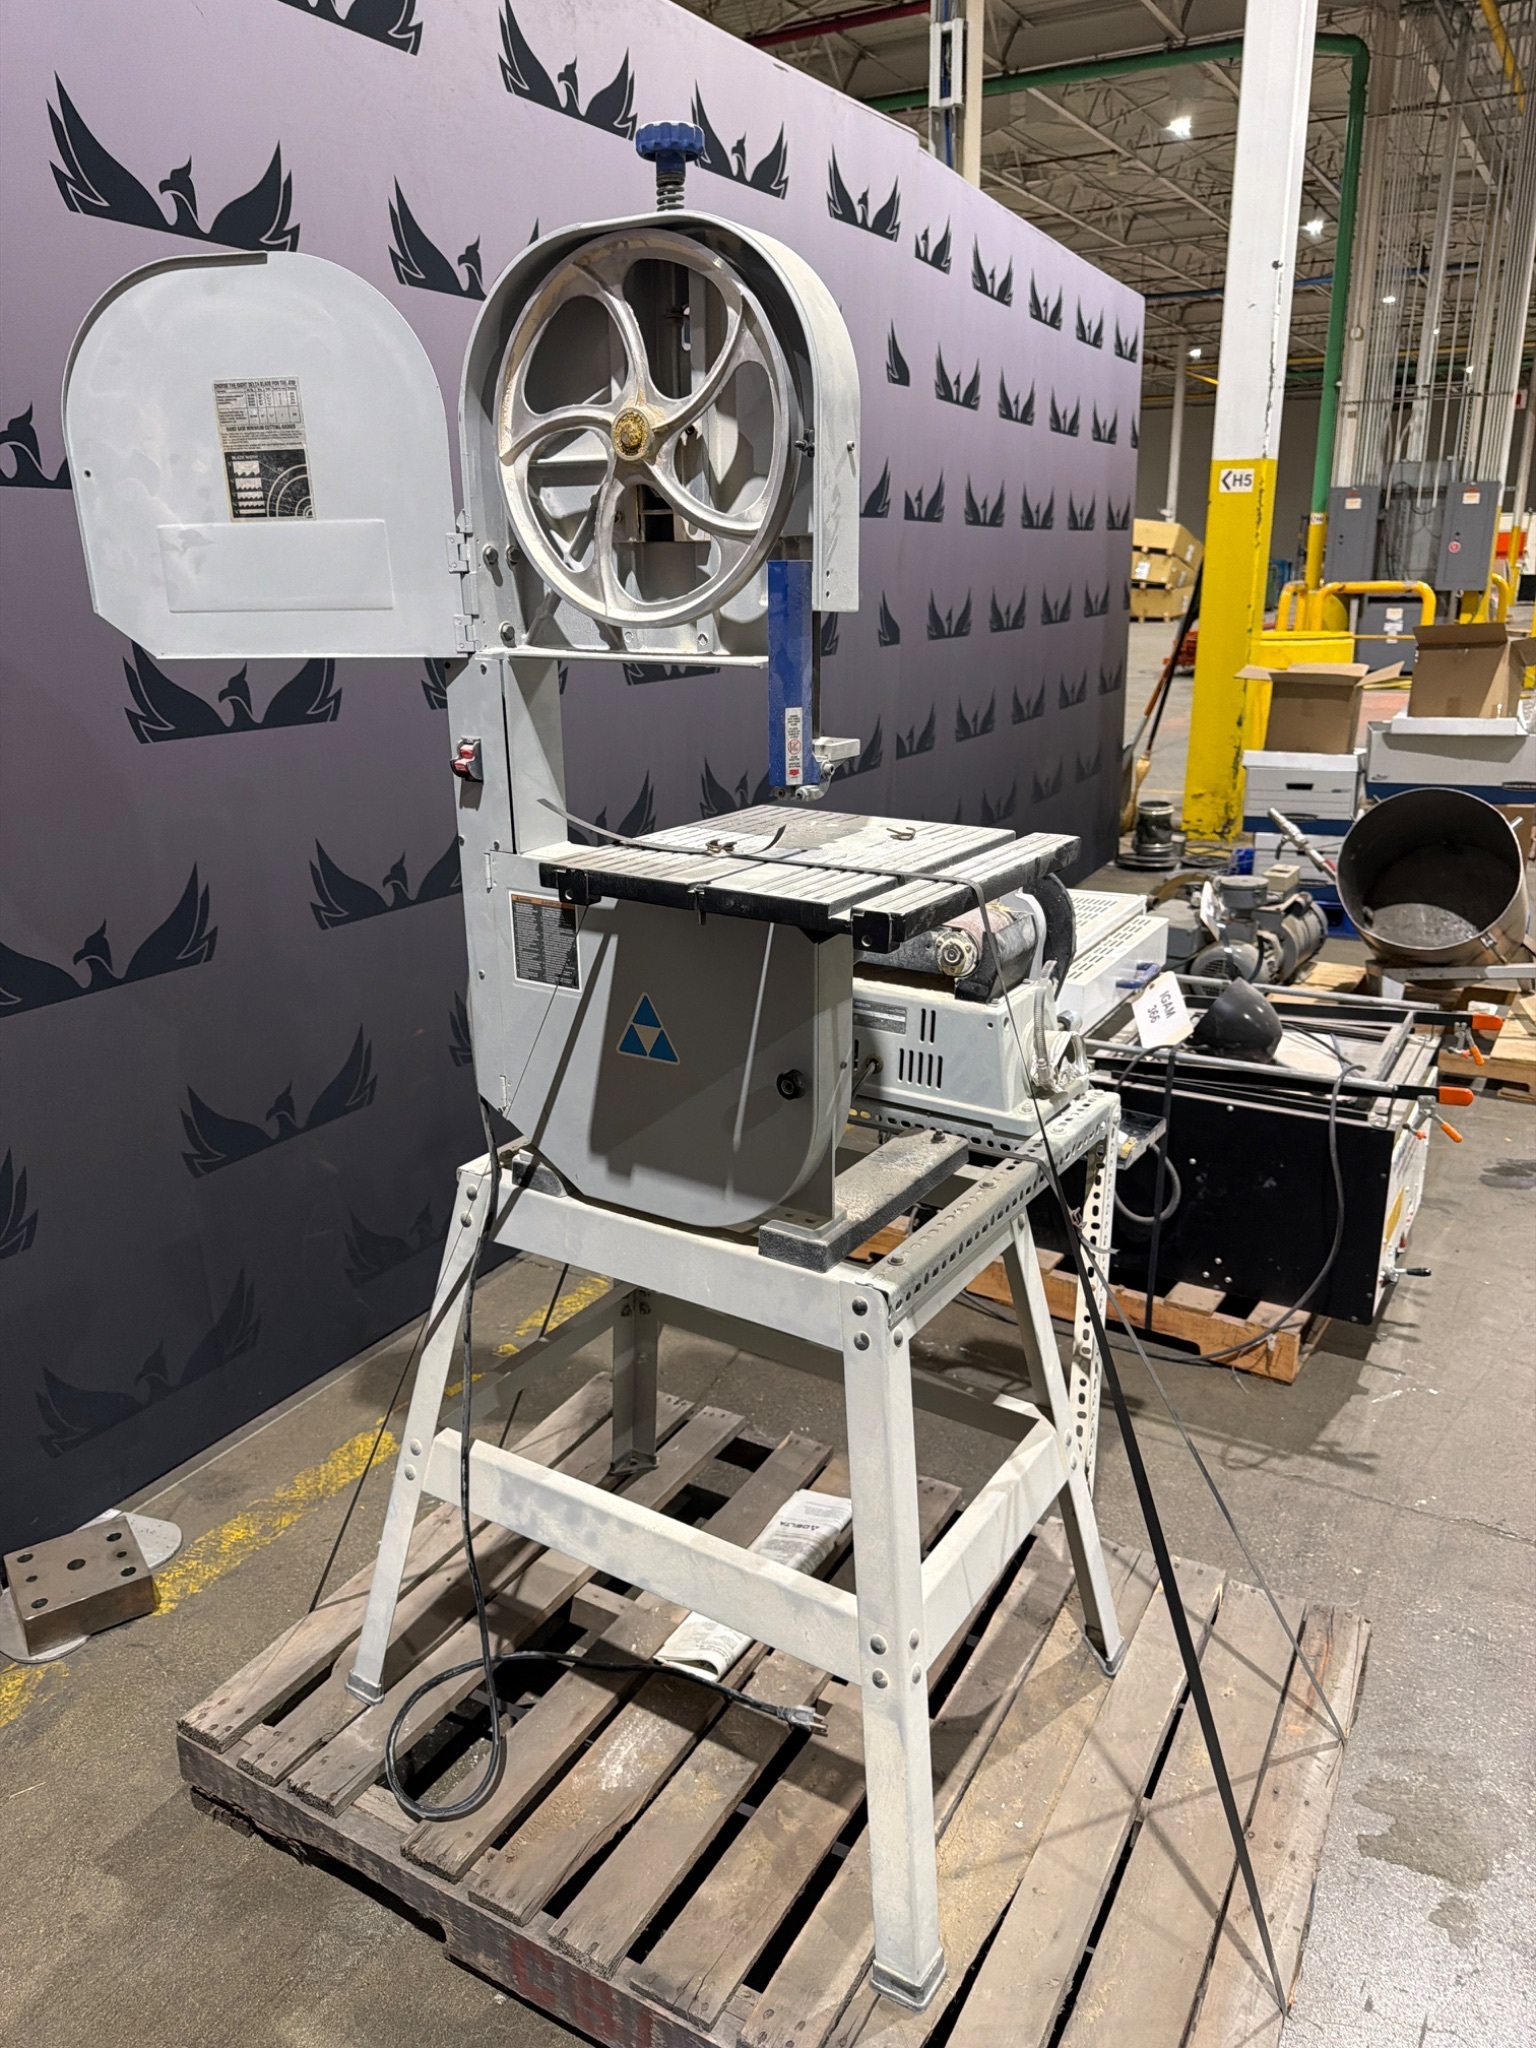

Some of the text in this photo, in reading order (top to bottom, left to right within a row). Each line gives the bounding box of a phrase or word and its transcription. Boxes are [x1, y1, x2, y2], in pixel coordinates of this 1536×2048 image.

[1232, 474, 1252, 487] H5
[1160, 990, 1176, 1019] IGAM
[780, 1521, 810, 1530] DELTA
